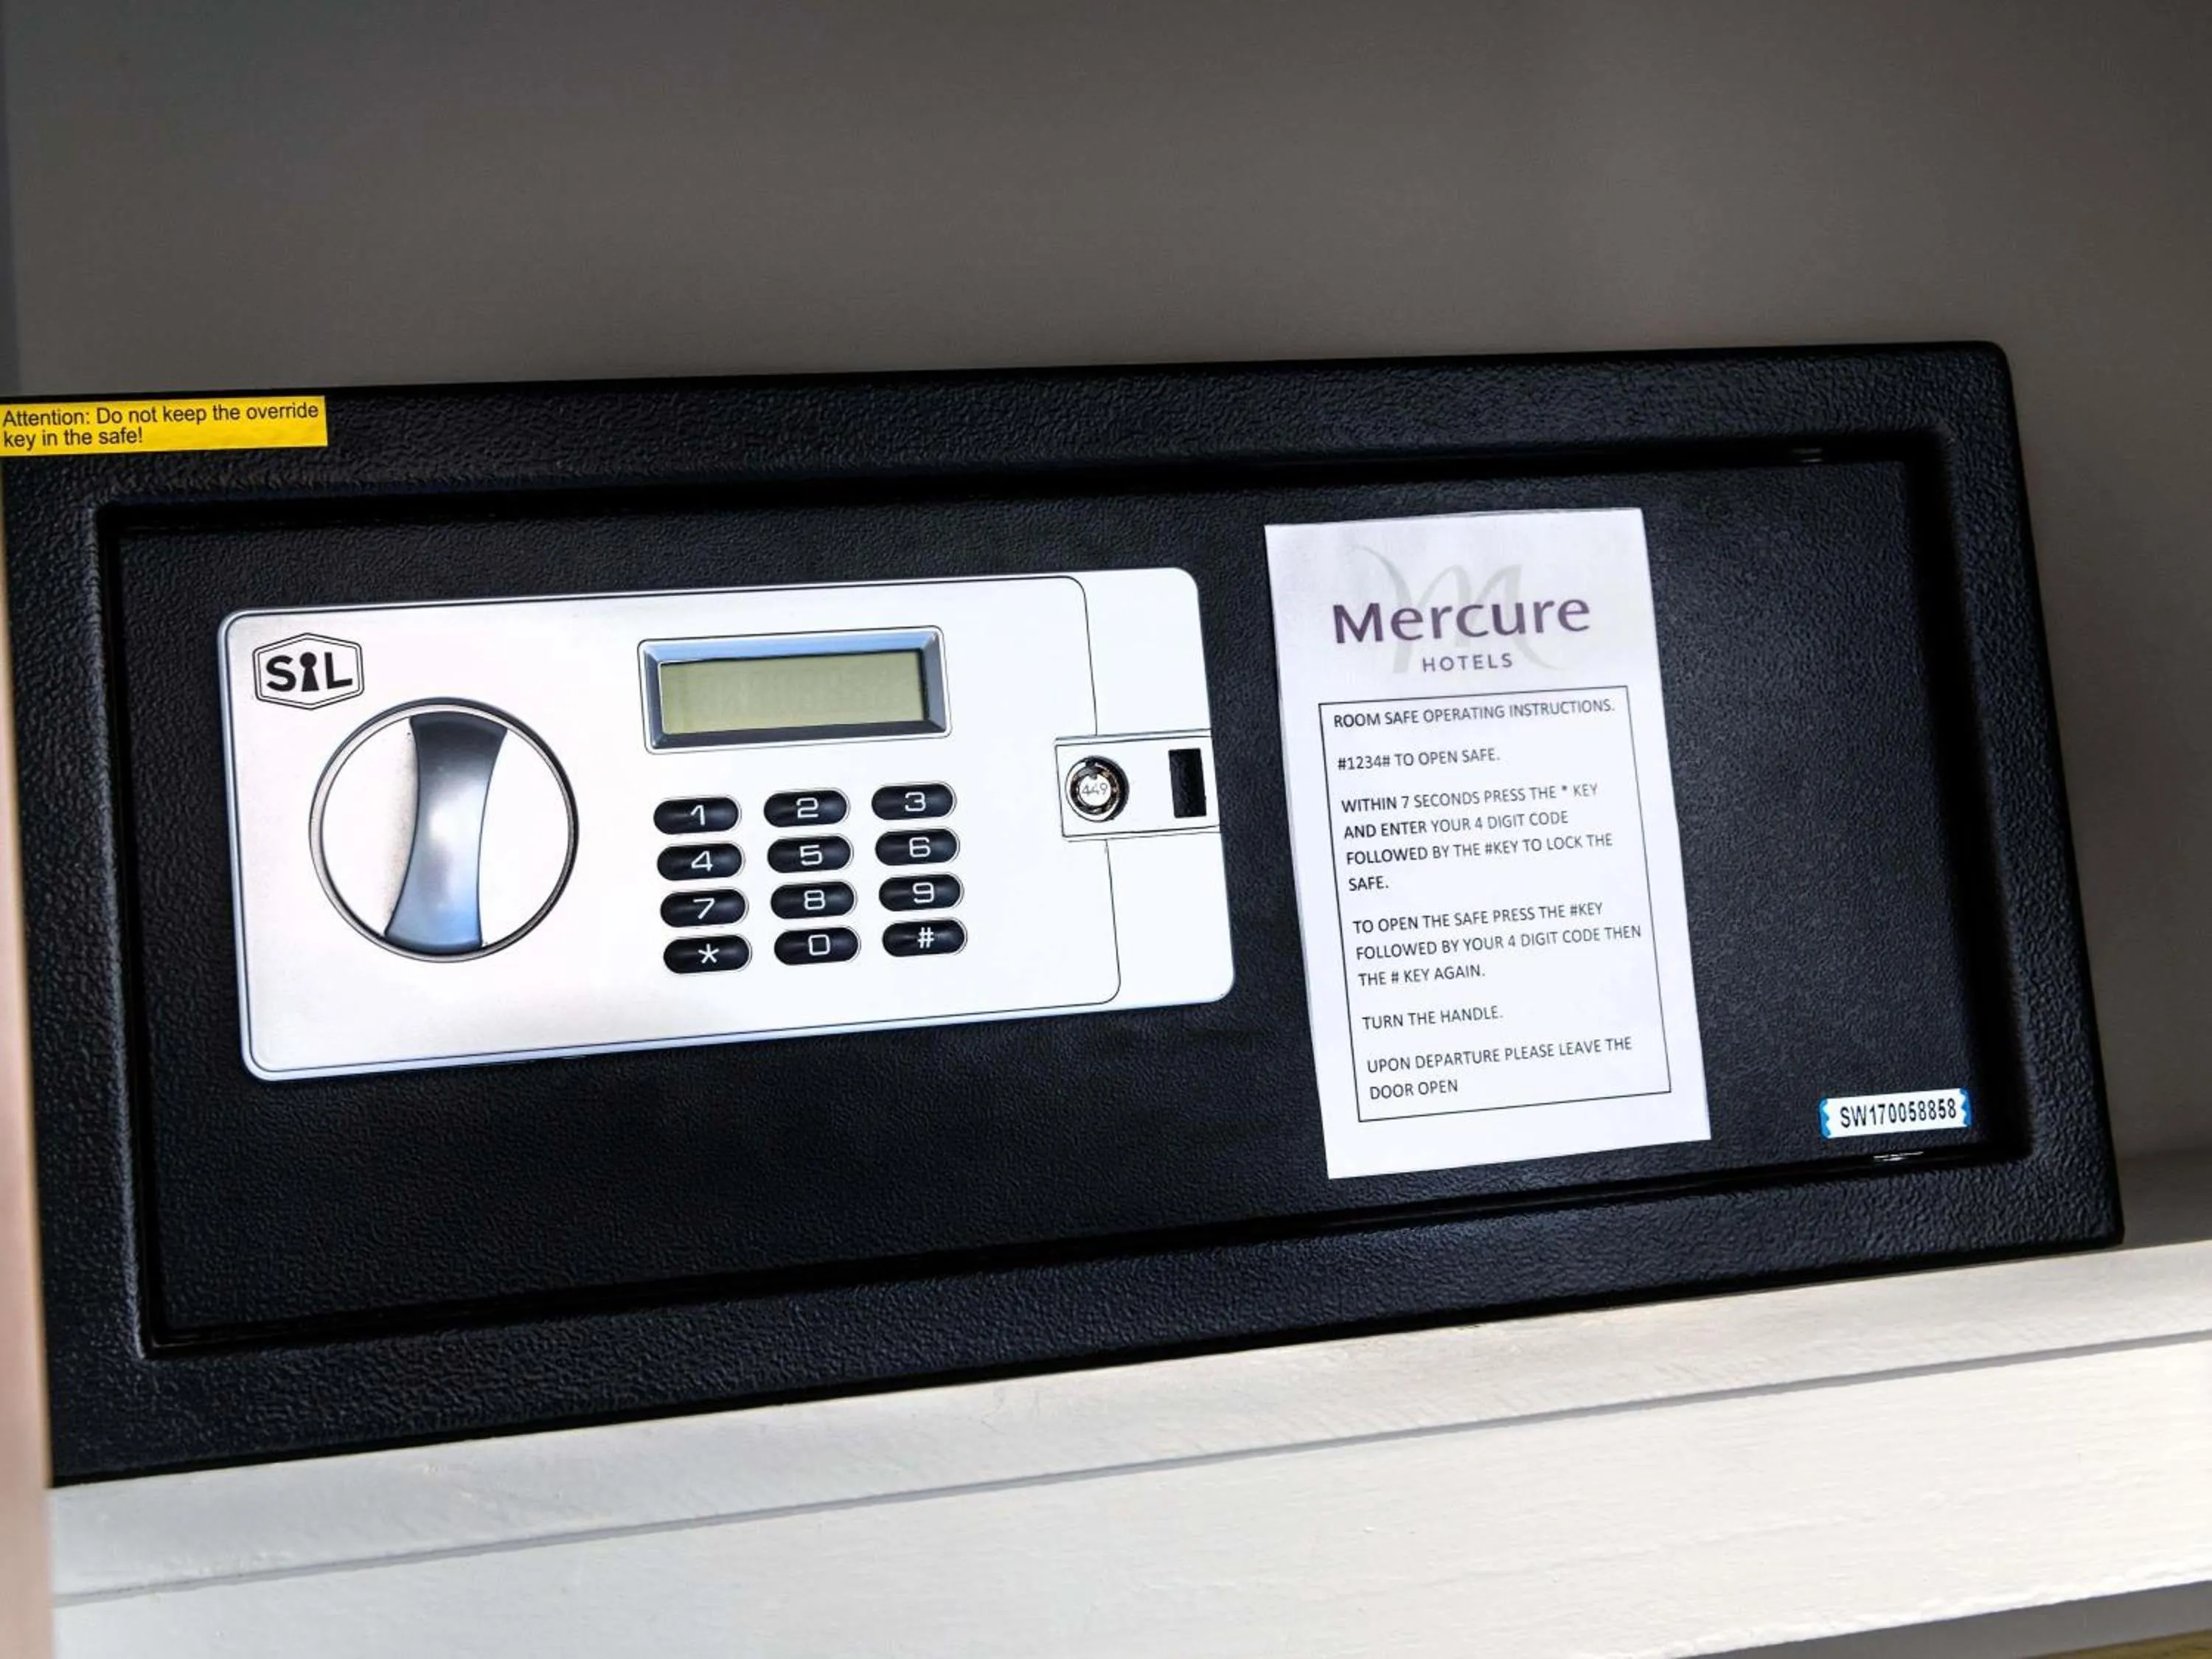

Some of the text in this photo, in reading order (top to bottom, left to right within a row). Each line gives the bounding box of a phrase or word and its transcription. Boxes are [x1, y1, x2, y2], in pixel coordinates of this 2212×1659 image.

[3, 402, 319, 427] Attention: Do not keep the override
[4, 427, 142, 451] key in the safe!
[1333, 599, 1590, 644] Mercure
[1422, 653, 1512, 672] HOTELS
[1334, 699, 1615, 727] ROOM SAFE OPERATING INSTRUCTIONS.
[1338, 748, 1500, 770] #1234# TO OPEN SAFE.
[796, 798, 818, 818] 2
[905, 792, 926, 811] 3
[1341, 796, 1397, 813] WITHIN
[1401, 796, 1409, 808] 7
[1414, 791, 1480, 808] SECONDS
[1484, 788, 1526, 802] PRESS
[1528, 786, 1557, 800] THE
[1573, 784, 1597, 796] KEY
[691, 805, 705, 825] 1
[1344, 811, 1568, 839] AND ENTER YOUR 4 DIGIT CODE
[800, 845, 822, 865] 5
[909, 837, 931, 857] 6
[1346, 833, 1613, 865] FOLLOWED BY THE #KEY TO LOCK THE
[692, 851, 712, 871] 4
[913, 883, 934, 903] 9
[1349, 876, 1388, 891] SAFE.
[694, 898, 714, 919] 7
[804, 890, 825, 910] 8
[1352, 902, 1602, 933] TO OPEN THE SAFE PRESS THE #KEY
[808, 935, 830, 956] 0
[918, 928, 934, 948] #
[1357, 925, 1641, 960] FOLLOWED BY YOUR 4 DIGIT CODE THEN
[1358, 964, 1485, 986] THE # KEY AGAIN.
[1362, 1006, 1503, 1029] TURN THE HANDLE.
[1367, 1037, 1632, 1074] UPON DEPARTURE PLEASE LEAVE THE
[1370, 1079, 1458, 1099] DOOR OPEN
[1840, 1098, 1956, 1128] SW170058858
